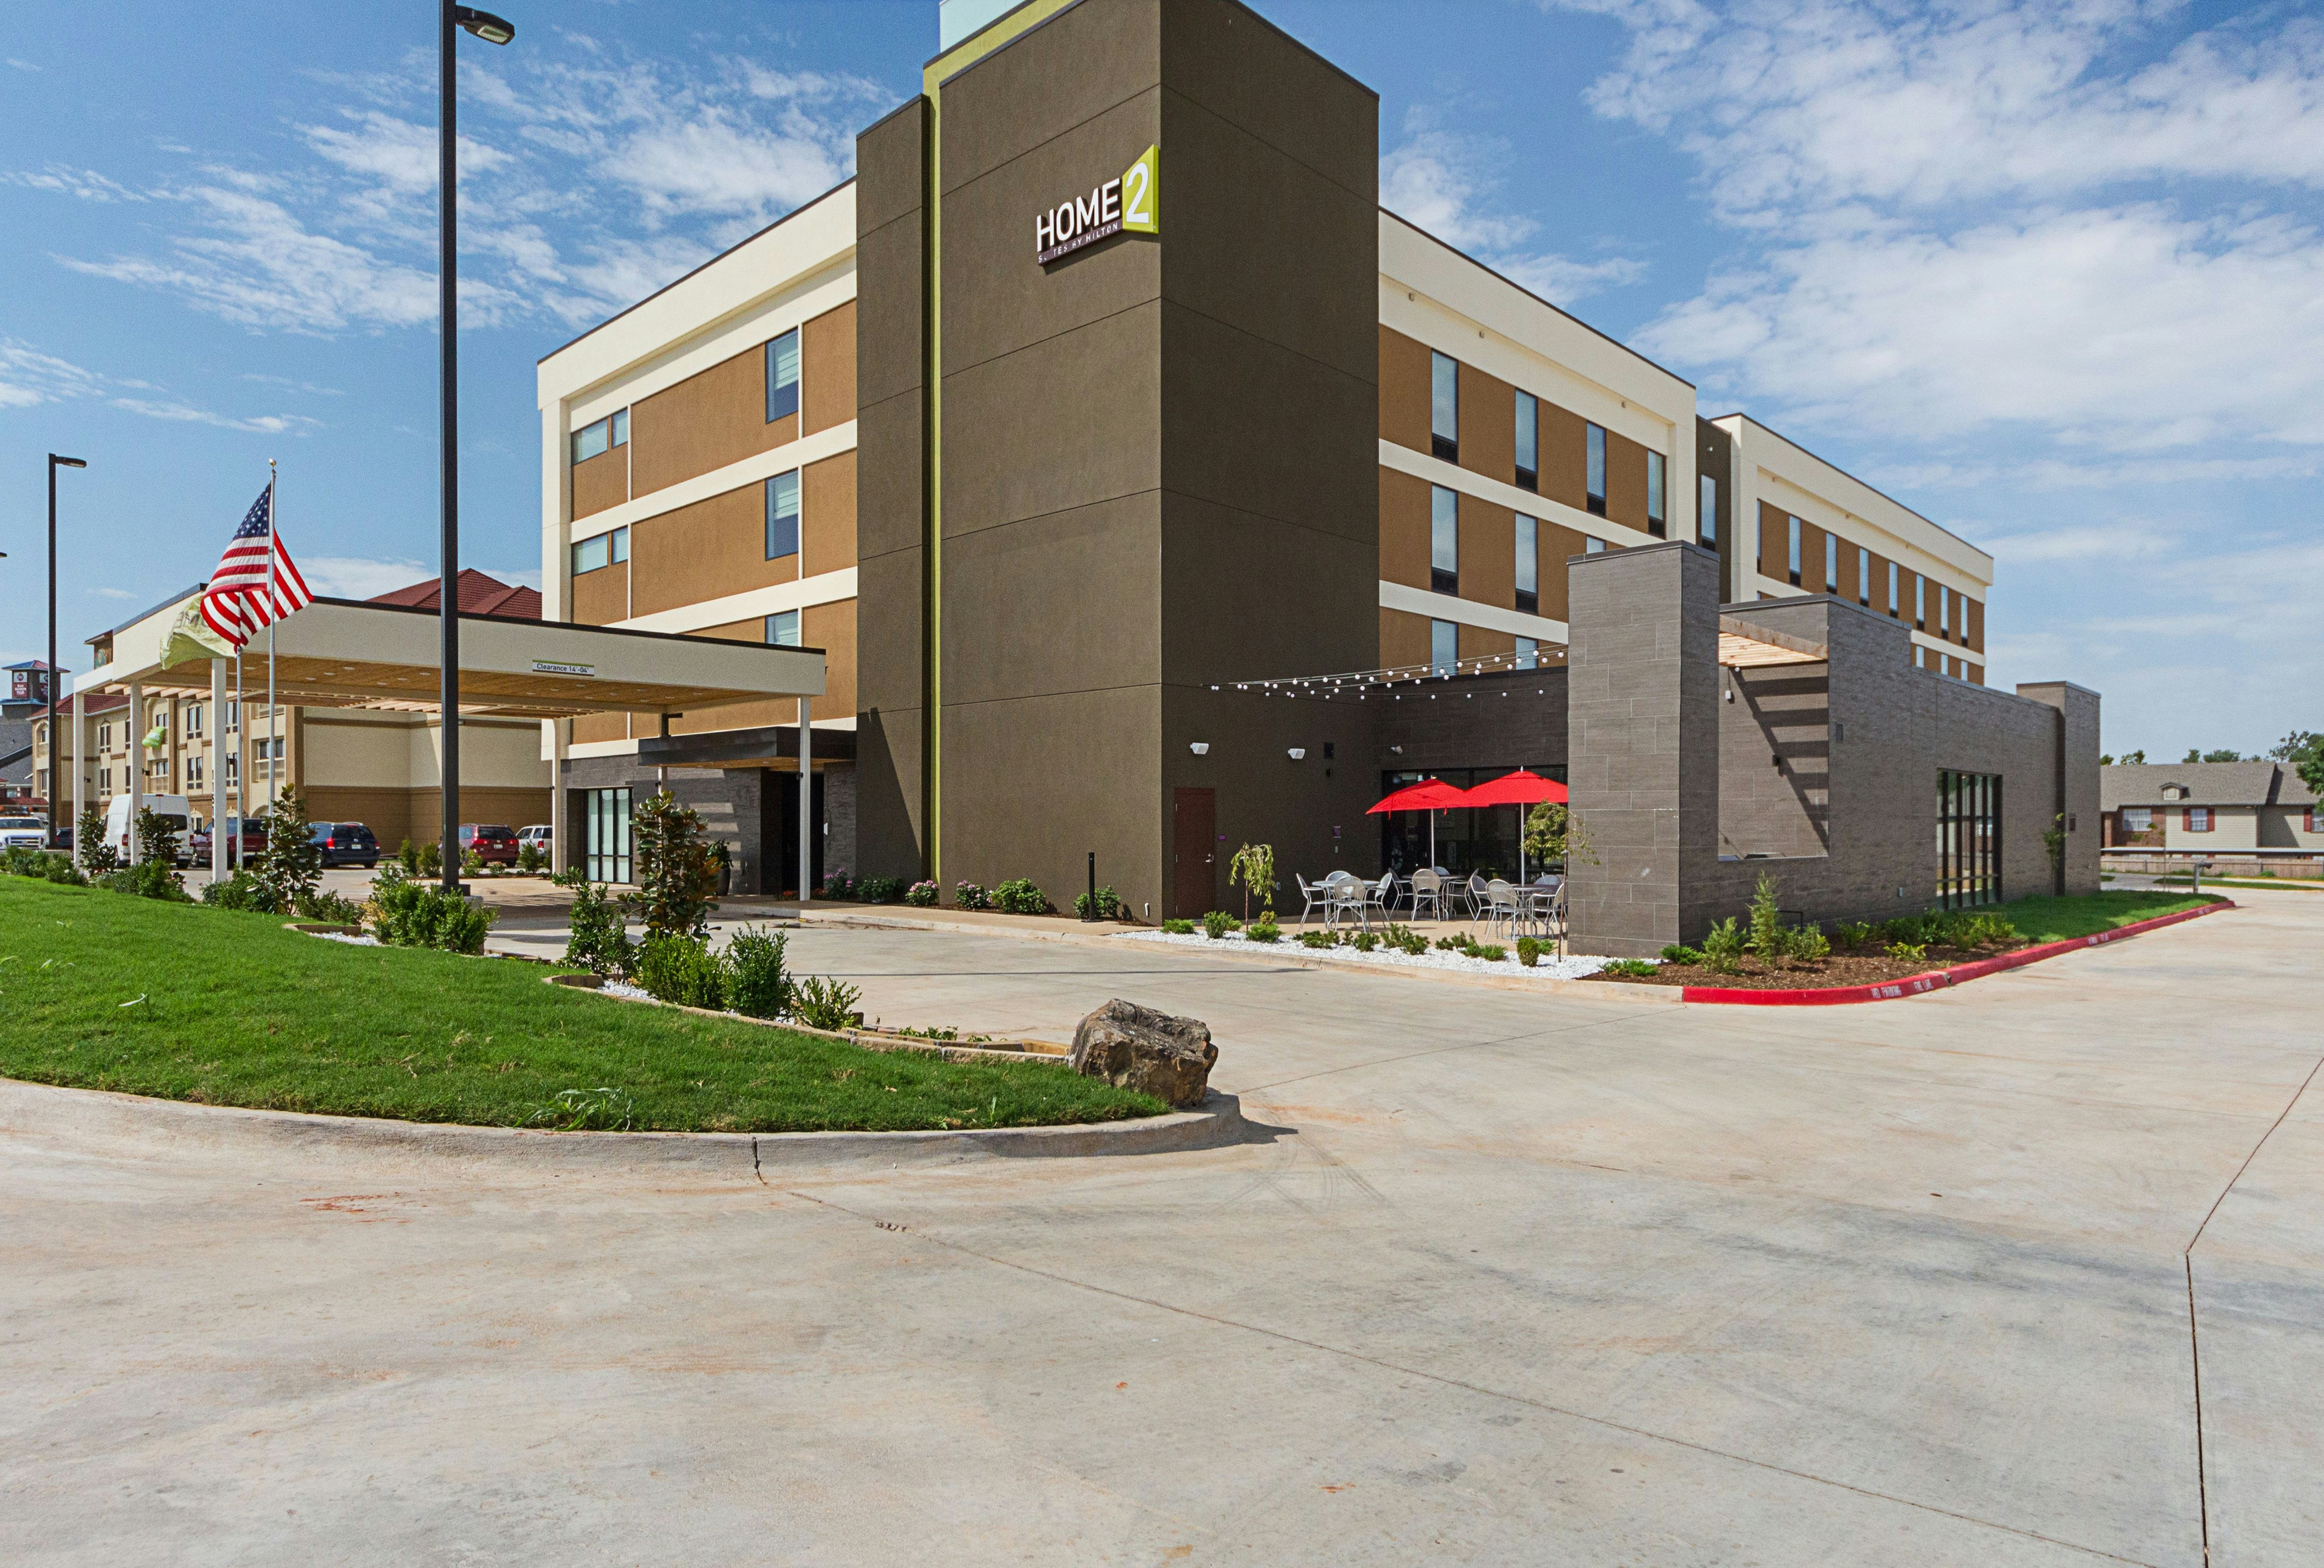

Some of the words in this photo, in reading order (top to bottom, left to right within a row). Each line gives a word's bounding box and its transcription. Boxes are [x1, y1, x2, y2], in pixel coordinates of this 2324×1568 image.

[1037, 178, 1120, 252] HOME
[1126, 162, 1149, 224] 2
[1039, 244, 1067, 263] STES
[1072, 238, 1082, 249] BY
[1086, 222, 1118, 242] HILTON
[537, 663, 567, 672] Clearance
